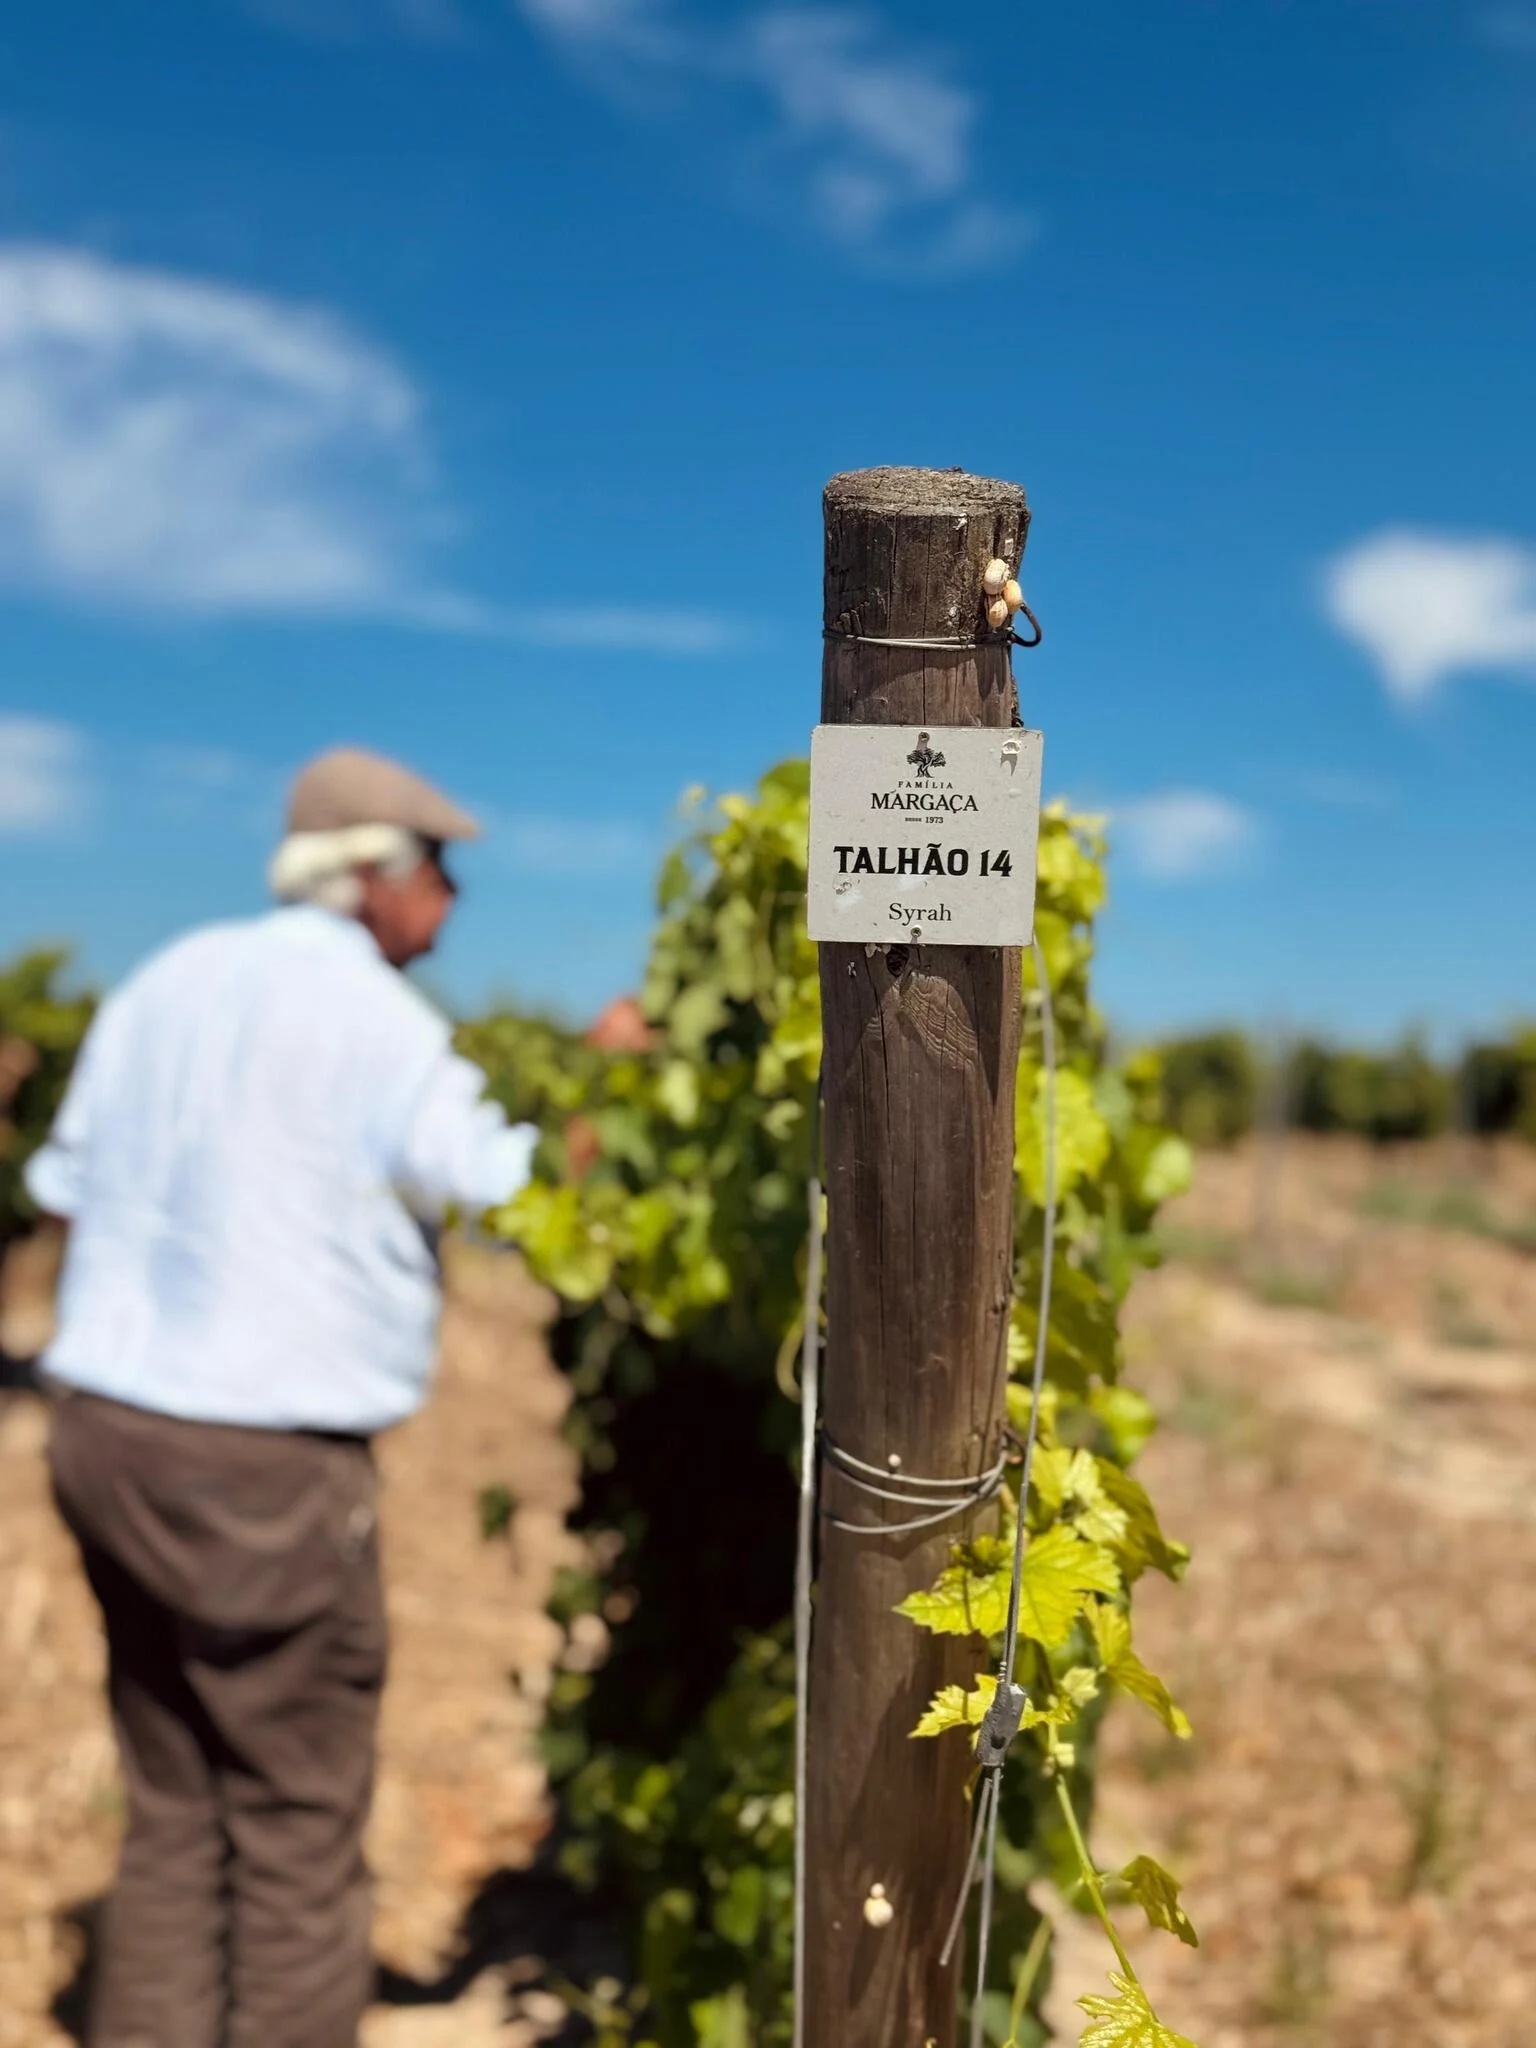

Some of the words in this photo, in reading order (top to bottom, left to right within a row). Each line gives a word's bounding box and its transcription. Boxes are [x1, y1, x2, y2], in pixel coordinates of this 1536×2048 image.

[898, 780, 953, 789] FAMÍLIA
[925, 816, 944, 824] 1973
[833, 843, 969, 876] TALHÃO
[979, 850, 1013, 877] 14
[889, 903, 952, 926] Syrah
